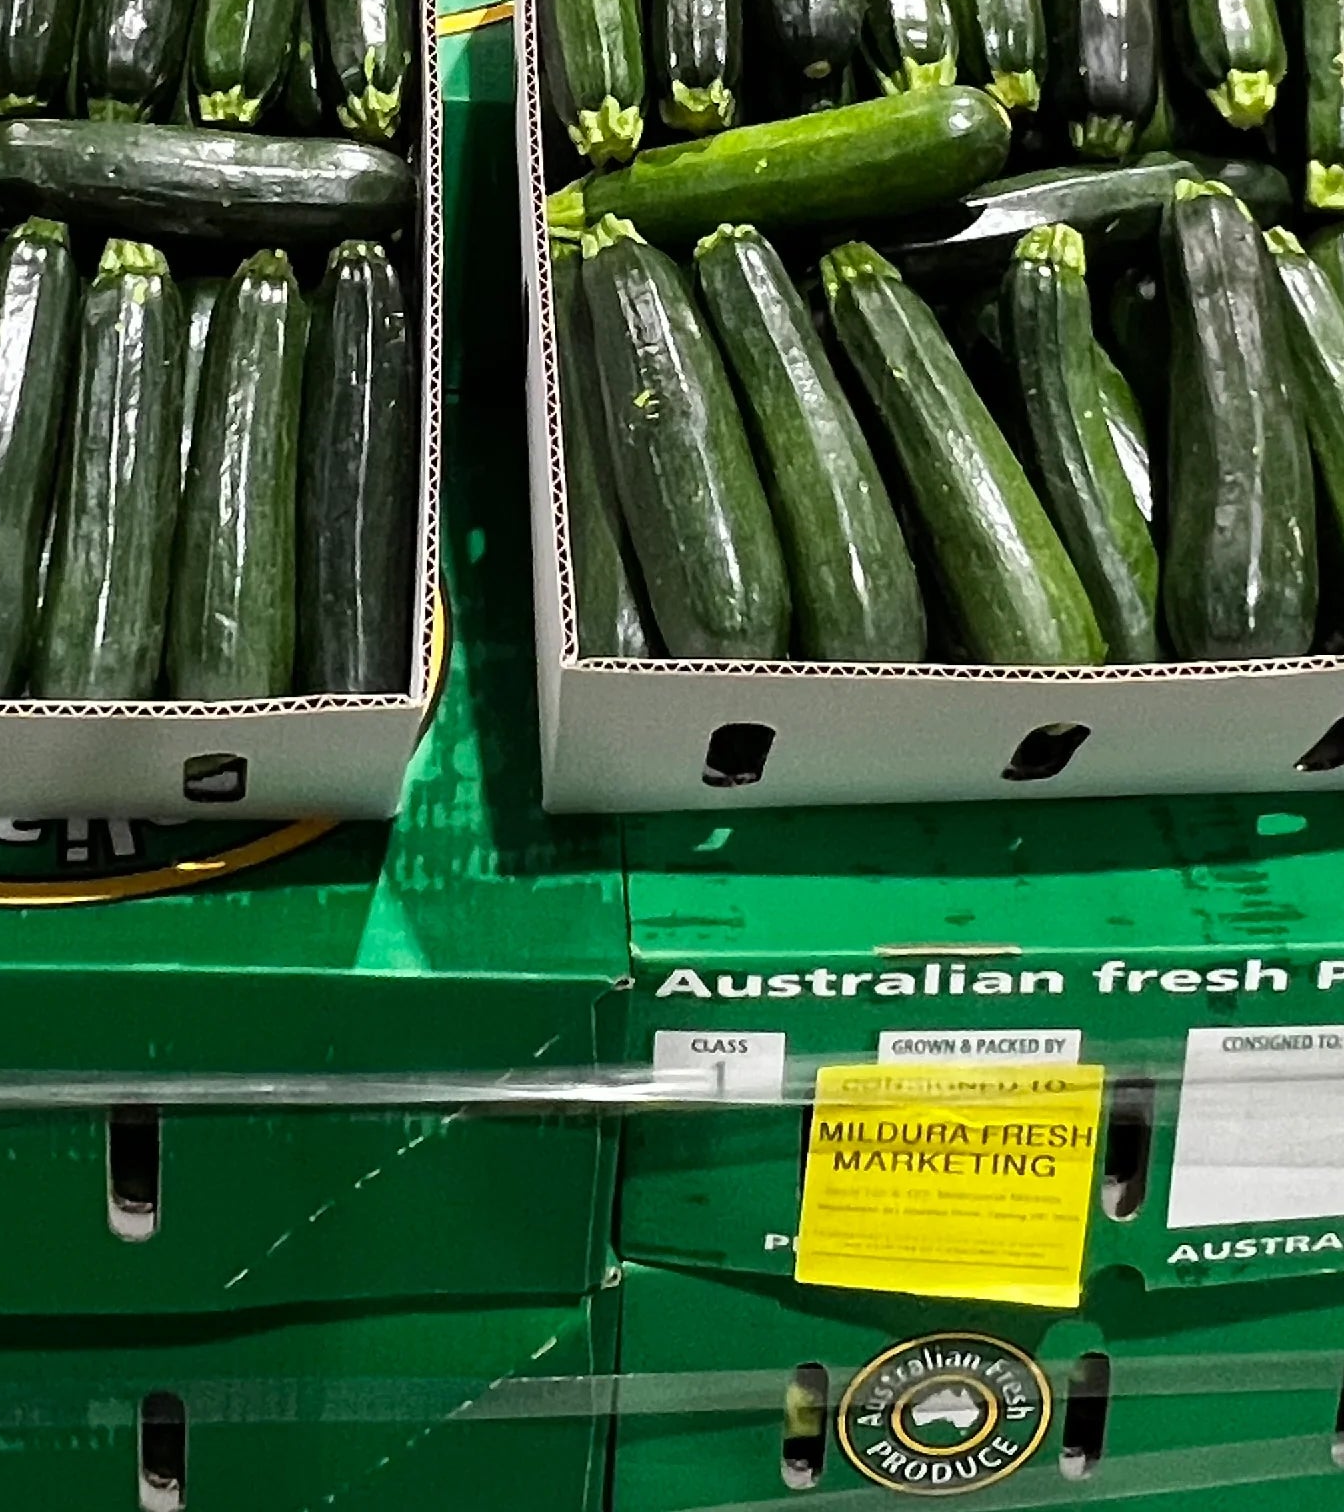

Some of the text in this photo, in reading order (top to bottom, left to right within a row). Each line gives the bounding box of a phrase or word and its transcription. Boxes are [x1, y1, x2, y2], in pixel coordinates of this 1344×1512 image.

[655, 963, 1064, 998] Australian
[1093, 958, 1289, 993] fresh
[691, 1038, 749, 1054] CLASS
[891, 1038, 1067, 1055] GROWN & PACKED BY
[1221, 1034, 1344, 1053] CONSIGNED TO:
[819, 1121, 1093, 1149] MILDURA FRESH
[833, 1151, 1057, 1178] MARKETING
[857, 1346, 1036, 1429] Australian Fresh
[864, 1434, 1020, 1486] PRODUCE
